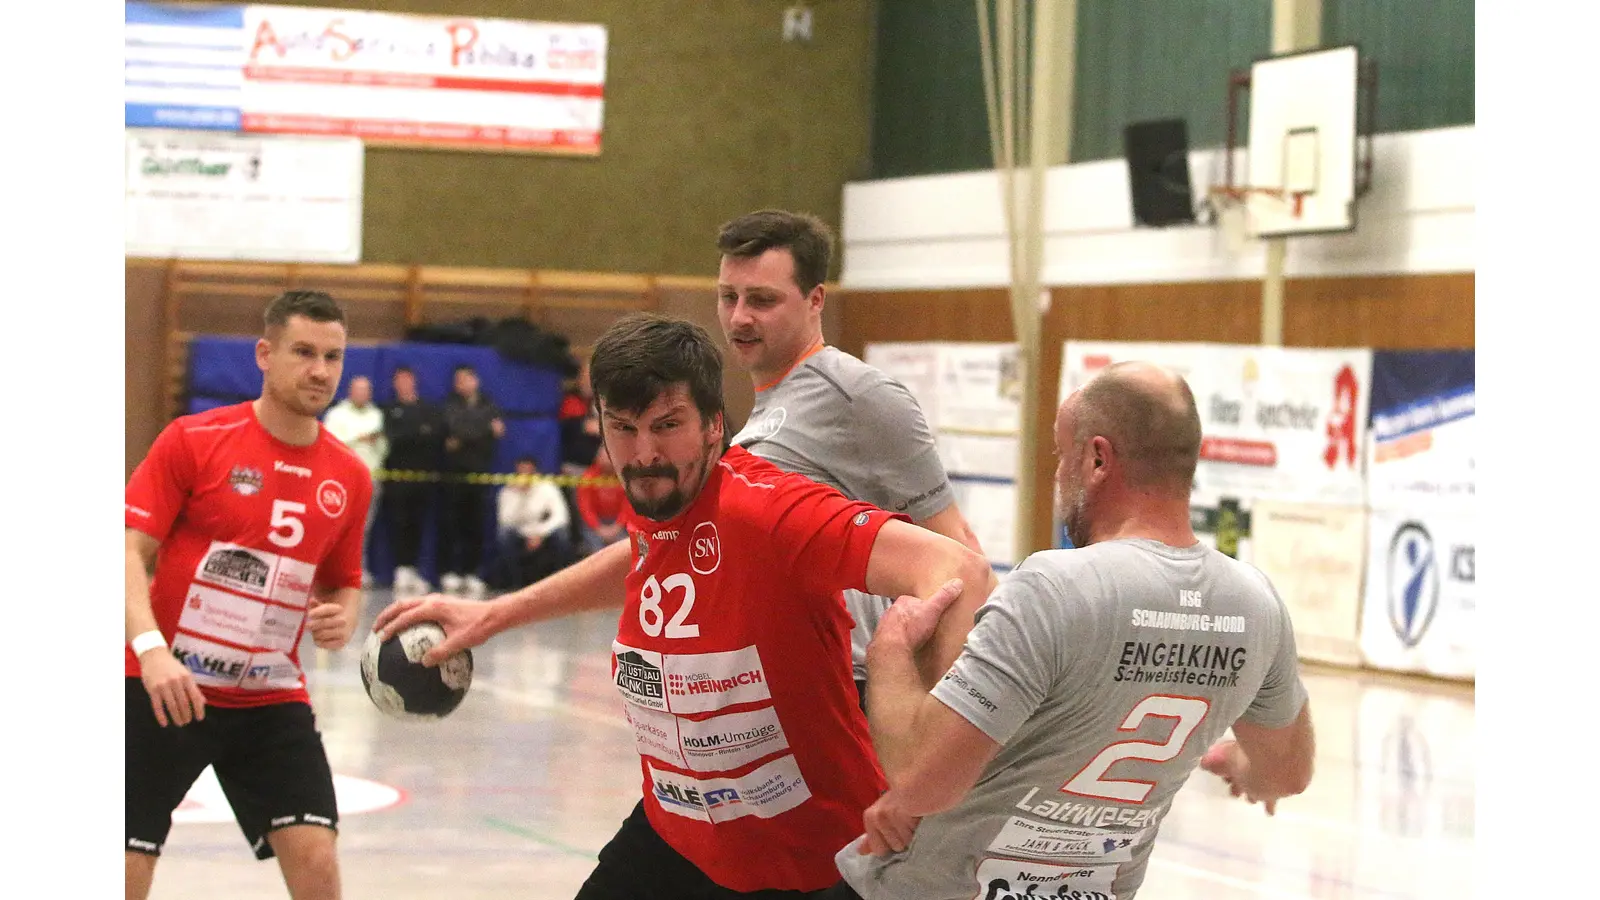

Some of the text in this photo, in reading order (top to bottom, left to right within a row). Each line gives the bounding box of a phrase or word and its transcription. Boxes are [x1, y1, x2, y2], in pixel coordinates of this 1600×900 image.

[268, 499, 306, 547] 5
[695, 536, 716, 558] SN
[638, 572, 700, 639] 82
[1179, 589, 1202, 607] HSG
[1131, 608, 1245, 633] SCHAUMBURG-NORD
[1119, 641, 1247, 671] ENGELKING
[687, 669, 762, 695] HEINRICH
[1113, 665, 1240, 688] Schweisstechnik
[684, 723, 776, 749] HOLM-Umzüge
[1059, 693, 1211, 805] 2
[760, 785, 793, 805] Nienburg
[1013, 819, 1035, 830] Ihre
[1022, 838, 1051, 851] JAHN
